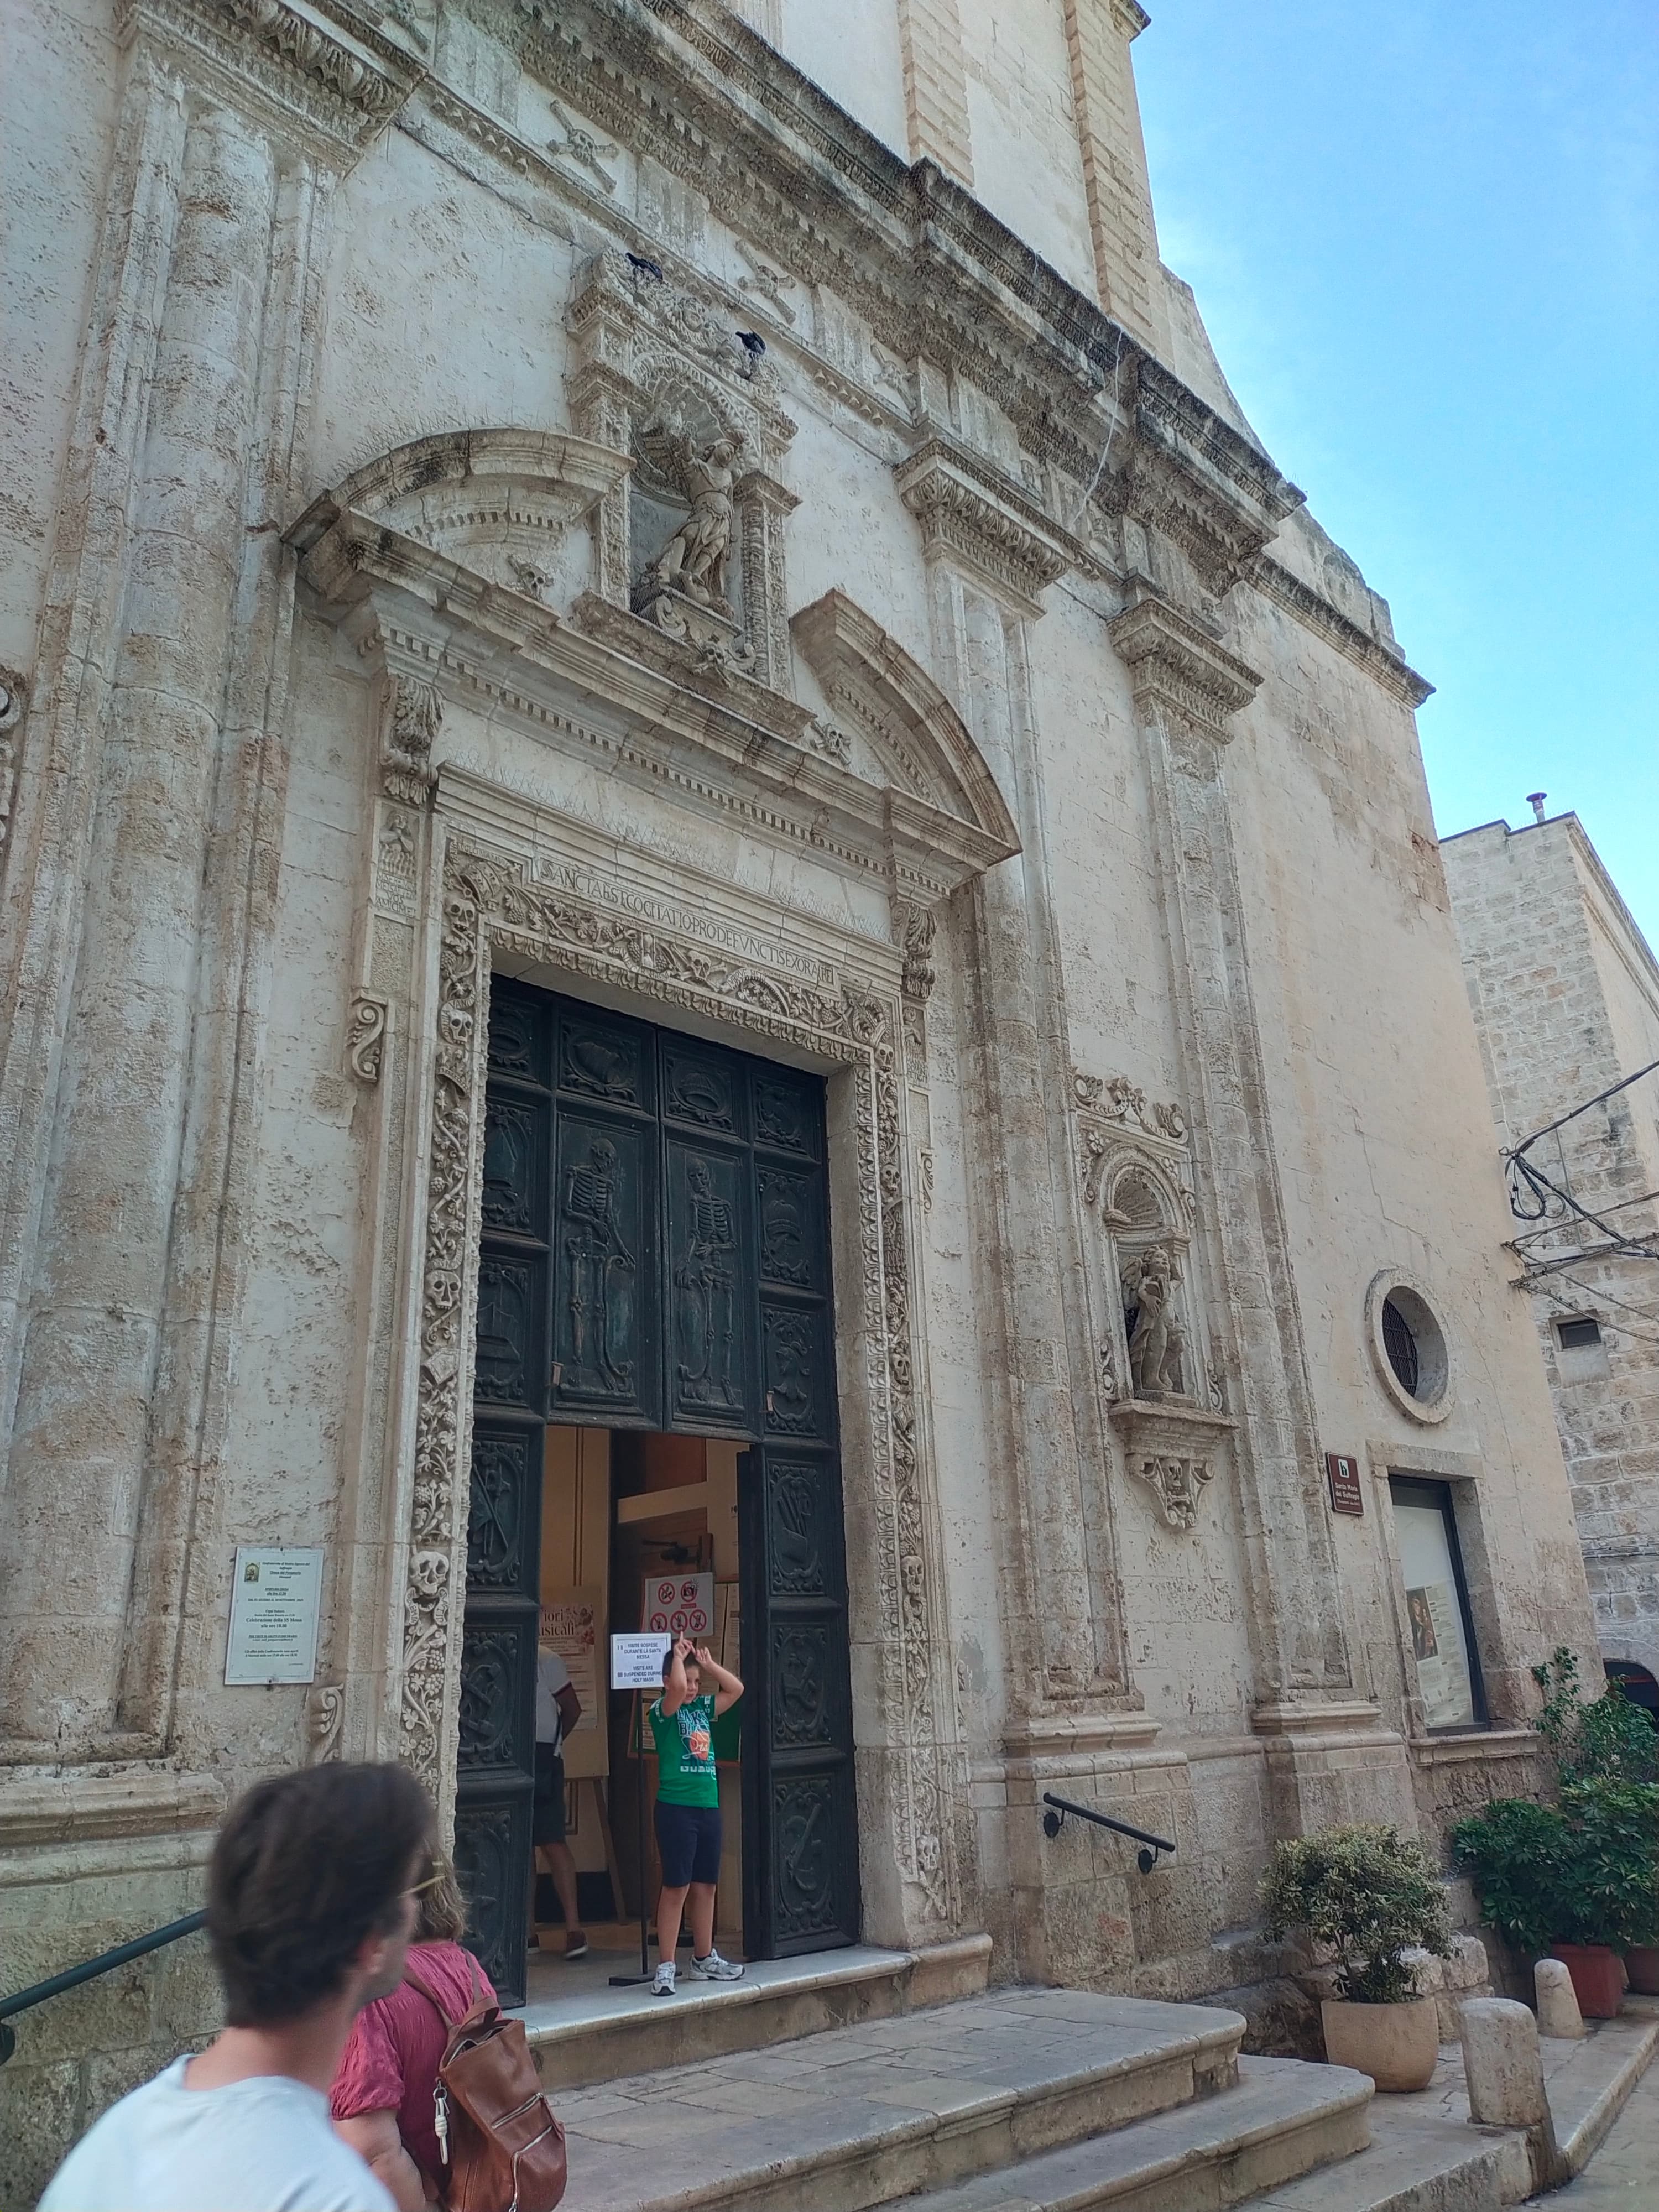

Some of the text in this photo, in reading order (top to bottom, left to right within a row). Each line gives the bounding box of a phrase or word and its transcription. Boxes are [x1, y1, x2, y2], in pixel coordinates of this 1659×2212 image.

[541, 860, 603, 899] SANCTA
[385, 890, 405, 905] VOS
[1335, 1481, 1358, 1492] Santa Maria
[1342, 1491, 1360, 1500] Suffragio
[544, 1608, 564, 1622] iori
[541, 1622, 575, 1636] sicali
